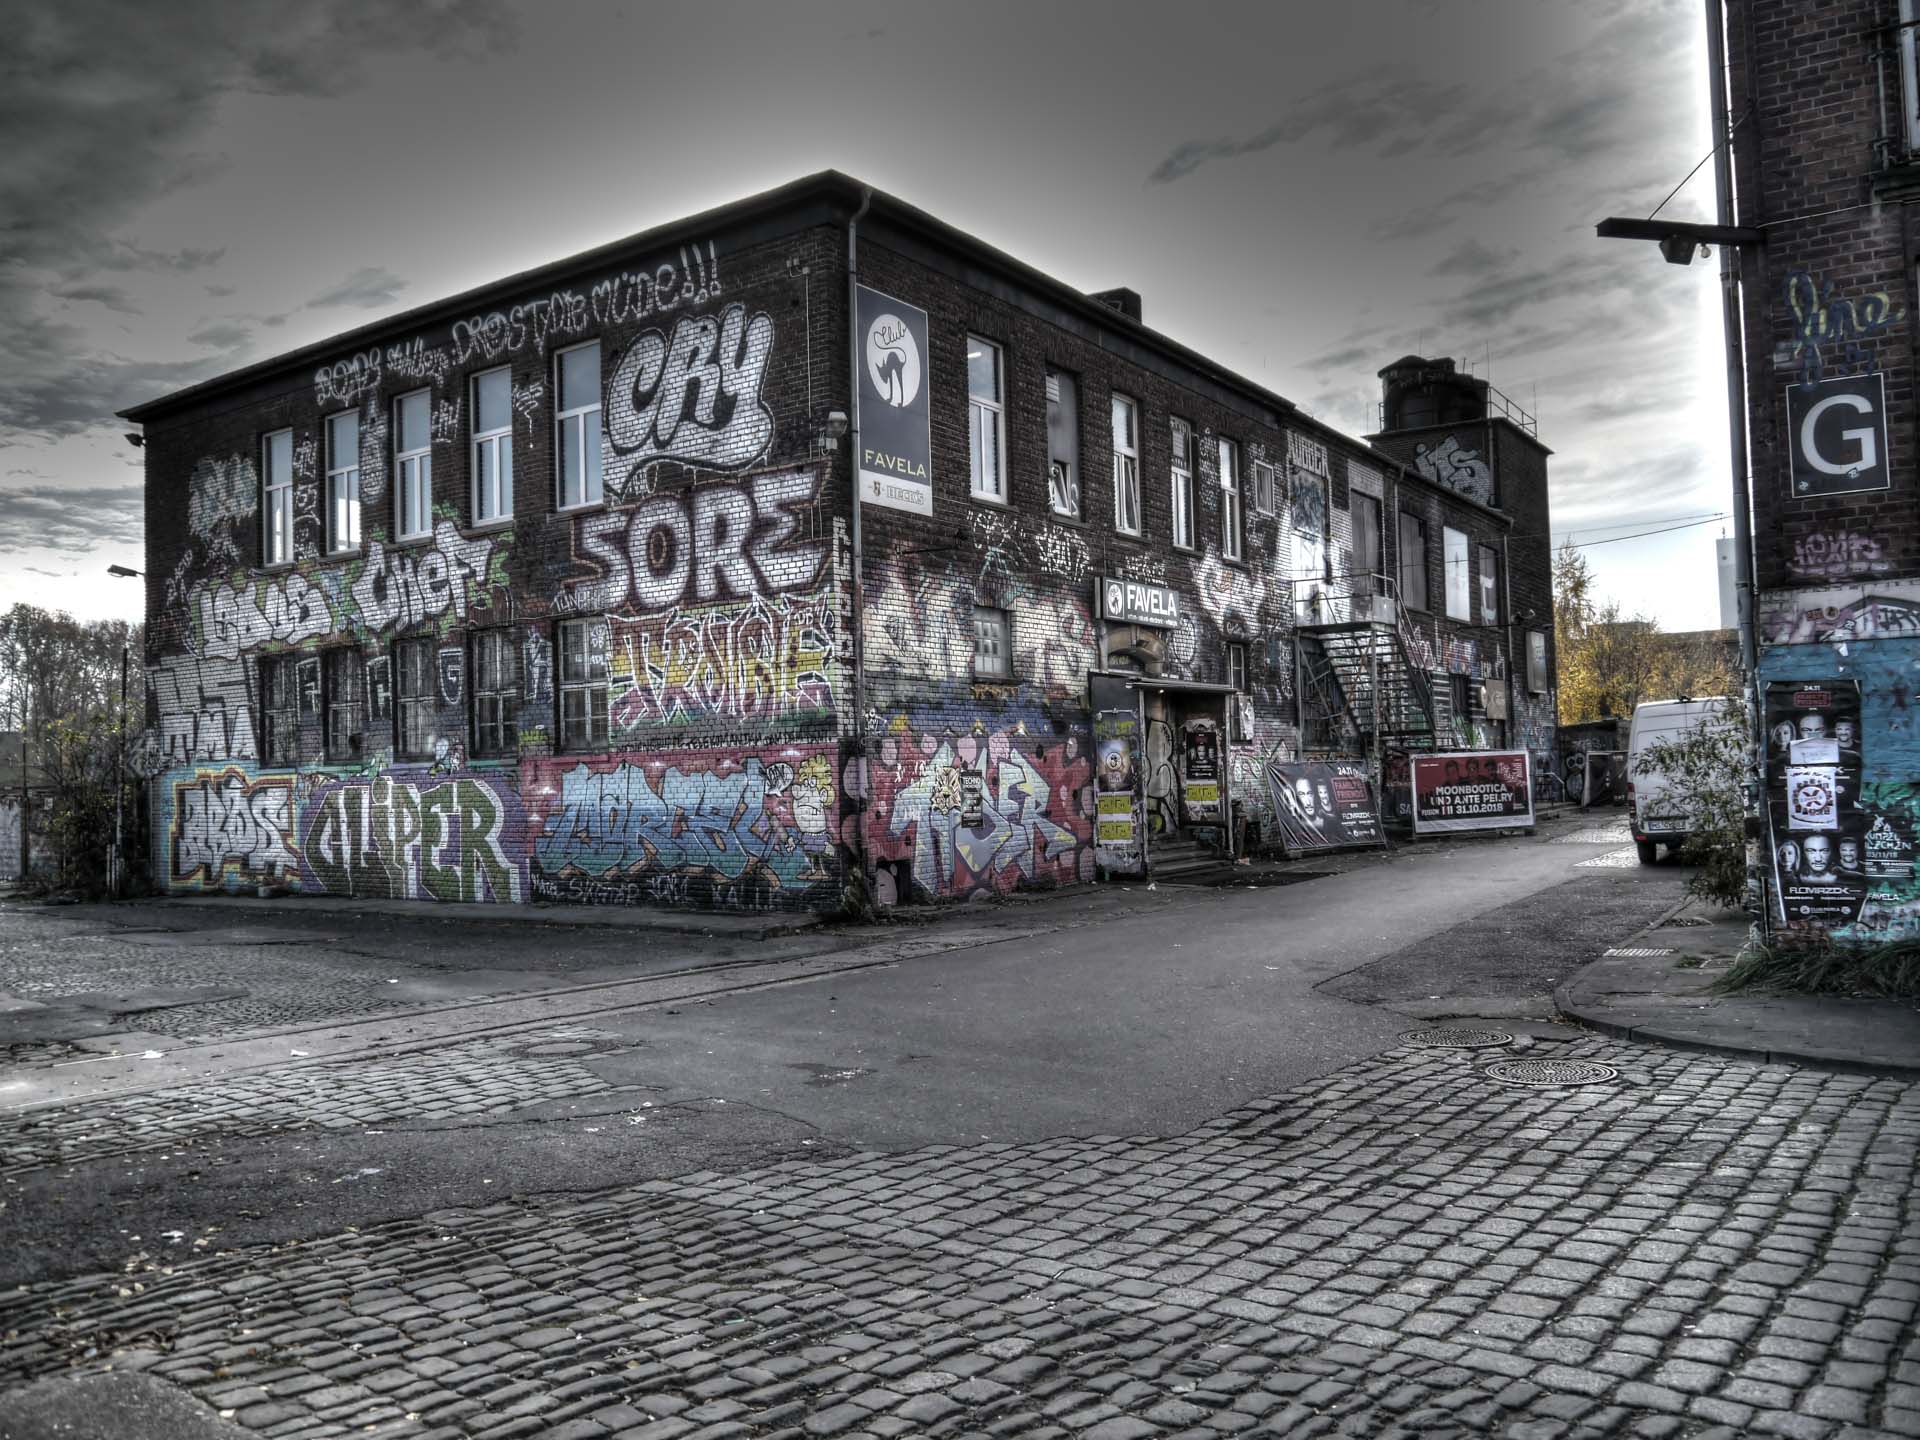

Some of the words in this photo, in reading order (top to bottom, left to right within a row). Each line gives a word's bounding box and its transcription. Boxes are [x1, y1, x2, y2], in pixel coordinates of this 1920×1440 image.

[874, 320, 907, 346] Club
[1800, 393, 1877, 475] G
[864, 448, 927, 479] FAVELA
[1126, 584, 1177, 617] FAVELA
[962, 776, 981, 785] TECHNO
[1436, 783, 1508, 796] MOONBOOTICA
[1454, 794, 1481, 804] ANTE
[1456, 803, 1504, 814] 31.10.2018
[1867, 893, 1900, 901] FAVELA
